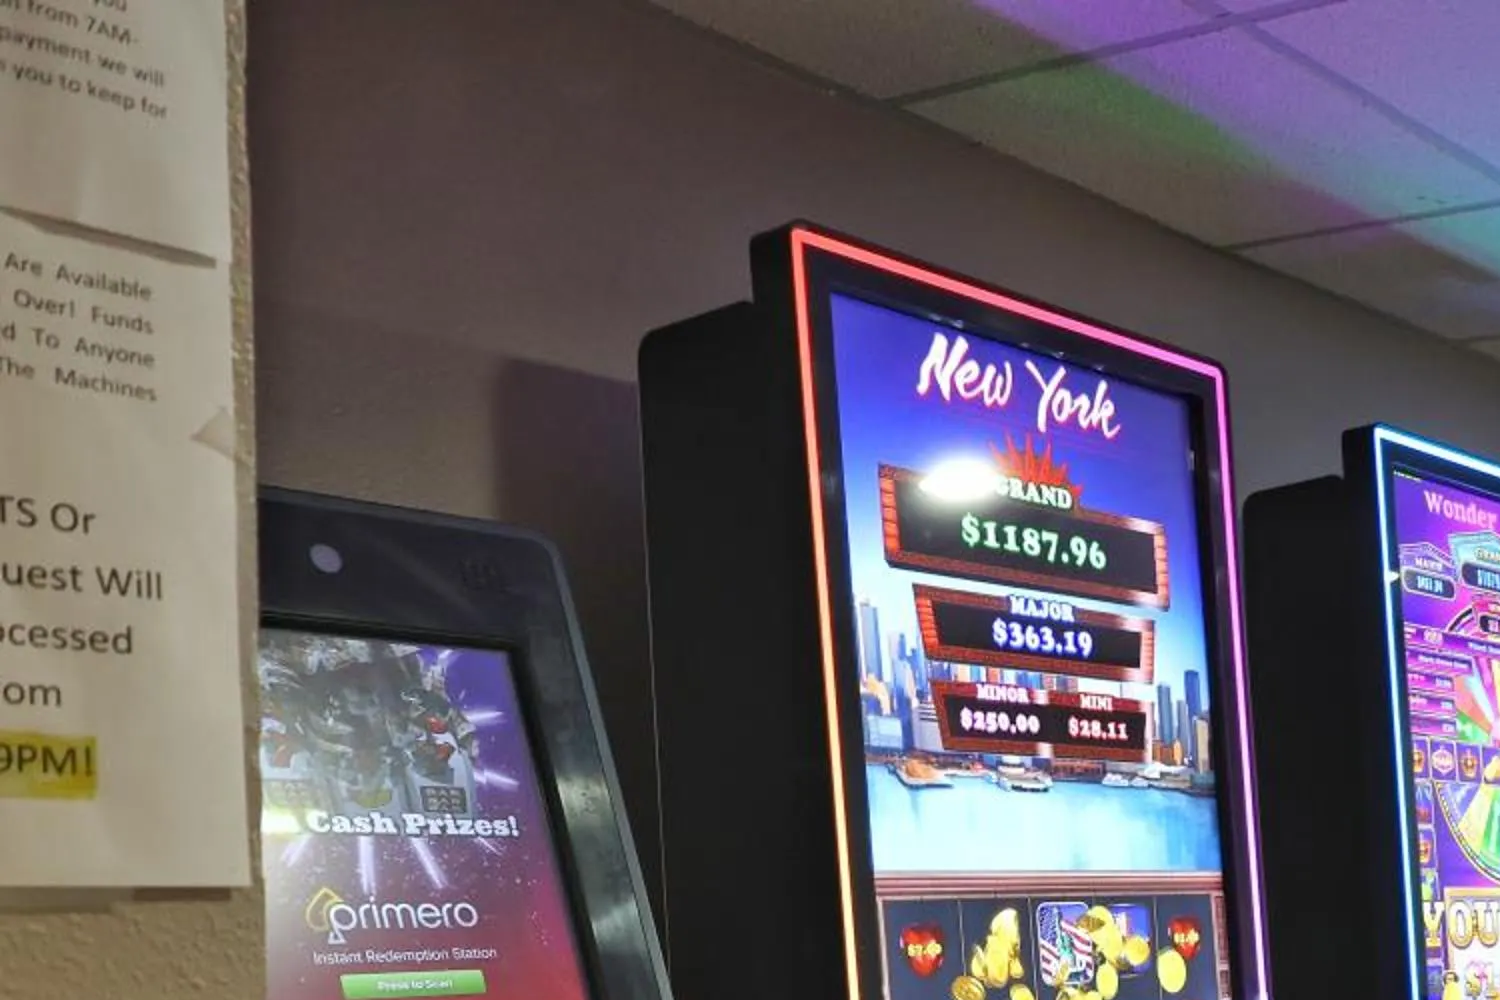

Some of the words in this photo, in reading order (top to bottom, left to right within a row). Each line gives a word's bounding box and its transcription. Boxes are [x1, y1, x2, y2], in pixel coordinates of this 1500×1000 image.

[27, 0, 78, 28] from
[98, 54, 127, 75] we
[133, 67, 164, 88] will
[14, 63, 52, 86] you
[59, 74, 81, 93] to
[87, 80, 135, 112] keep
[141, 96, 167, 118] for
[5, 252, 42, 277] Are
[56, 264, 152, 301] Available
[91, 305, 154, 334] Funds
[31, 327, 60, 349] To
[75, 337, 155, 368] Anyone
[55, 367, 157, 401] Machines
[917, 332, 1013, 407] New
[1025, 360, 1121, 439] York
[995, 476, 1072, 509] GRAND
[1424, 490, 1497, 529] Wonder
[50, 503, 96, 534] Or
[961, 512, 1107, 569] $1187.96
[96, 566, 162, 600] Will
[1010, 595, 1074, 622] MAJOR
[992, 622, 1093, 657] $363.19
[976, 684, 1029, 703] MINOR
[1080, 694, 1113, 711] MINI
[960, 707, 1040, 734] $250.00
[1068, 717, 1128, 740] $28.11
[0, 743, 95, 777] 9PM!
[306, 811, 397, 835] Cash
[403, 813, 520, 837] Prizes!
[328, 896, 478, 944] primero
[1422, 901, 1500, 949] YOU
[313, 950, 363, 966] Instant
[367, 949, 448, 964] Redemption
[453, 947, 497, 960] Station
